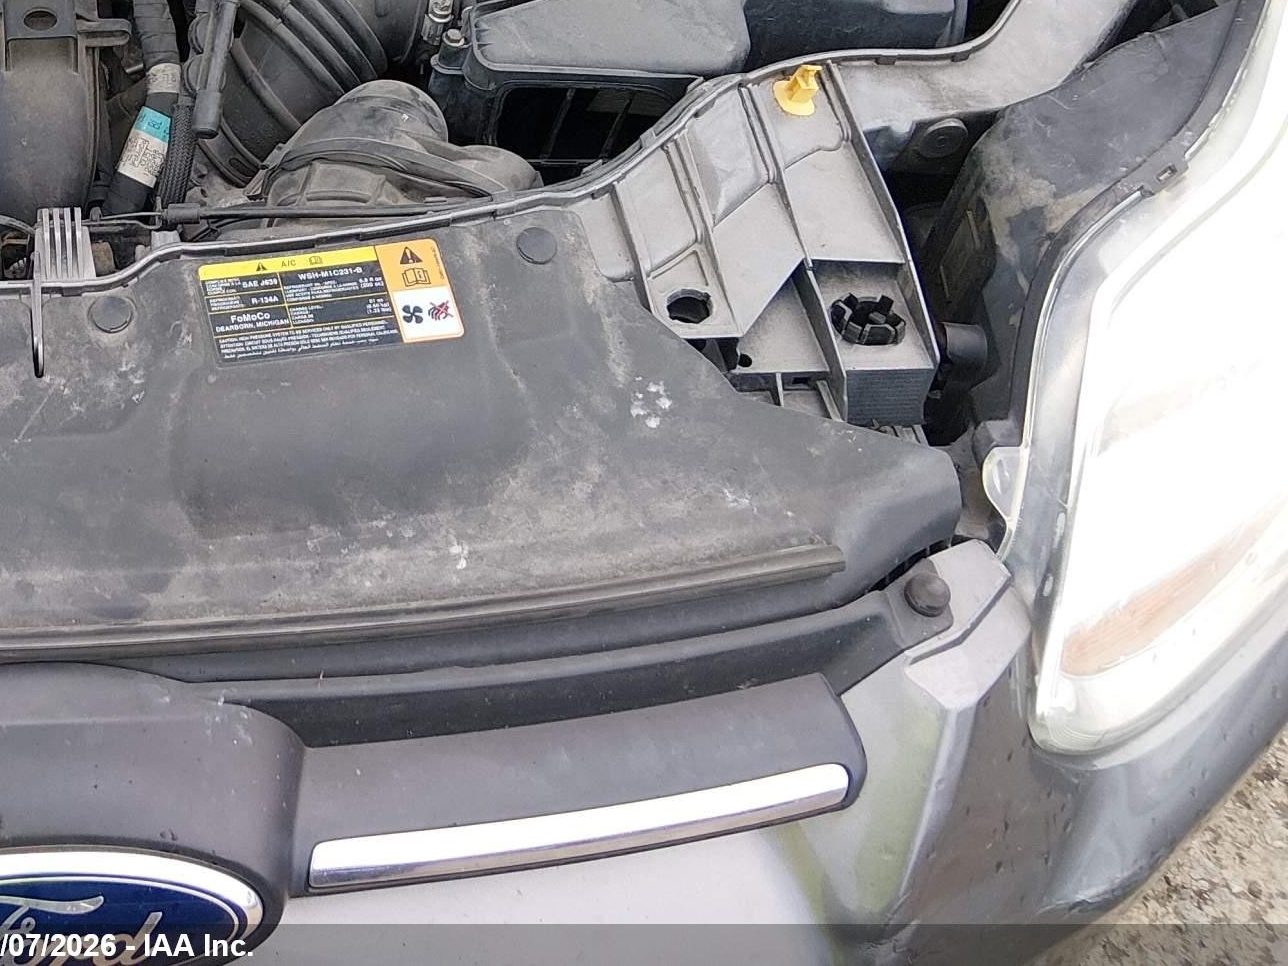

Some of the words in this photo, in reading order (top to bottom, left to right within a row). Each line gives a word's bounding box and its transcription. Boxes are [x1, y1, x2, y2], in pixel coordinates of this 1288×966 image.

[281, 260, 297, 268] A/C
[242, 280, 259, 288] SAE
[251, 295, 279, 305] R-134A
[230, 312, 271, 323] FoMoCo
[215, 323, 256, 333] DEARBORN,
[256, 319, 290, 328] MICHIGAN
